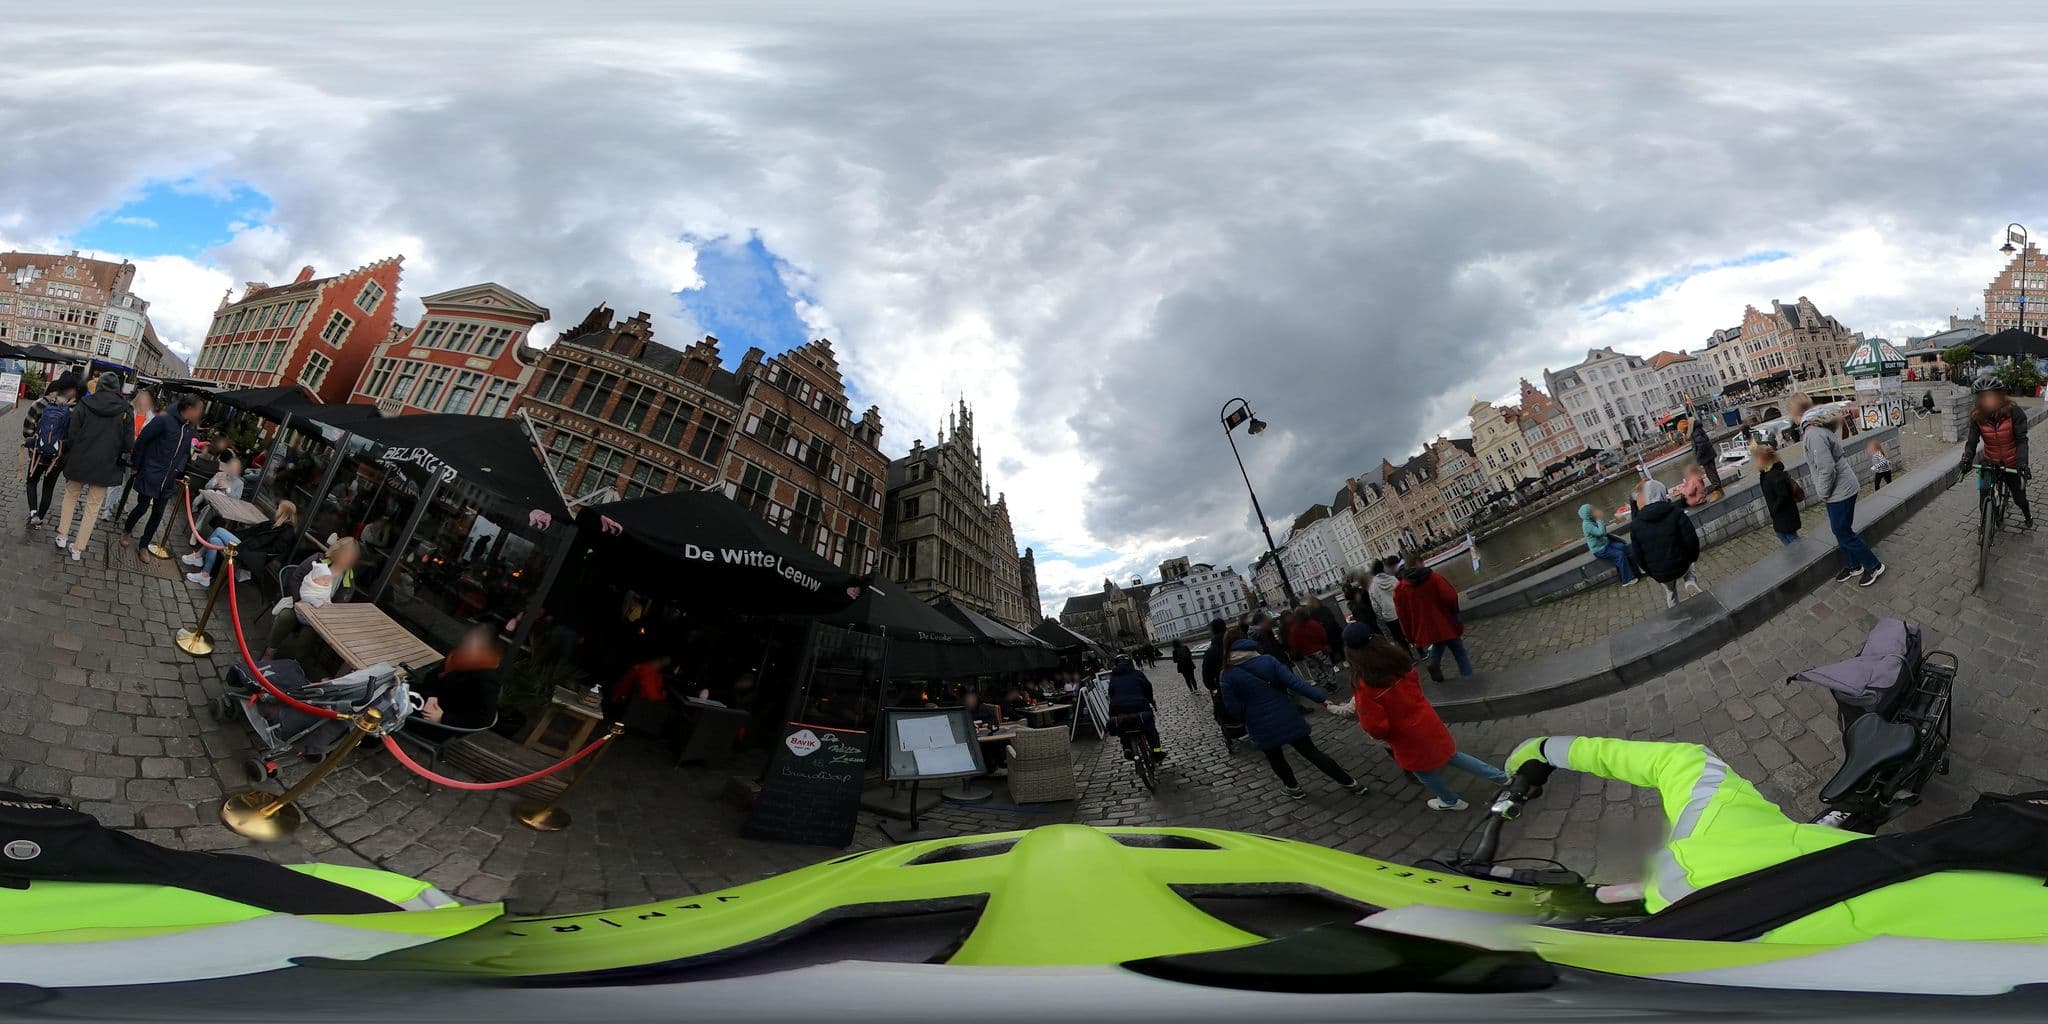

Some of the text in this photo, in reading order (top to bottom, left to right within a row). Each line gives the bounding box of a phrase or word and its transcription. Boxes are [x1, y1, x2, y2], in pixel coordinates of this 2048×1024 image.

[685, 543, 822, 592] De Witte Leeuw
[790, 737, 816, 748] BAVIK
